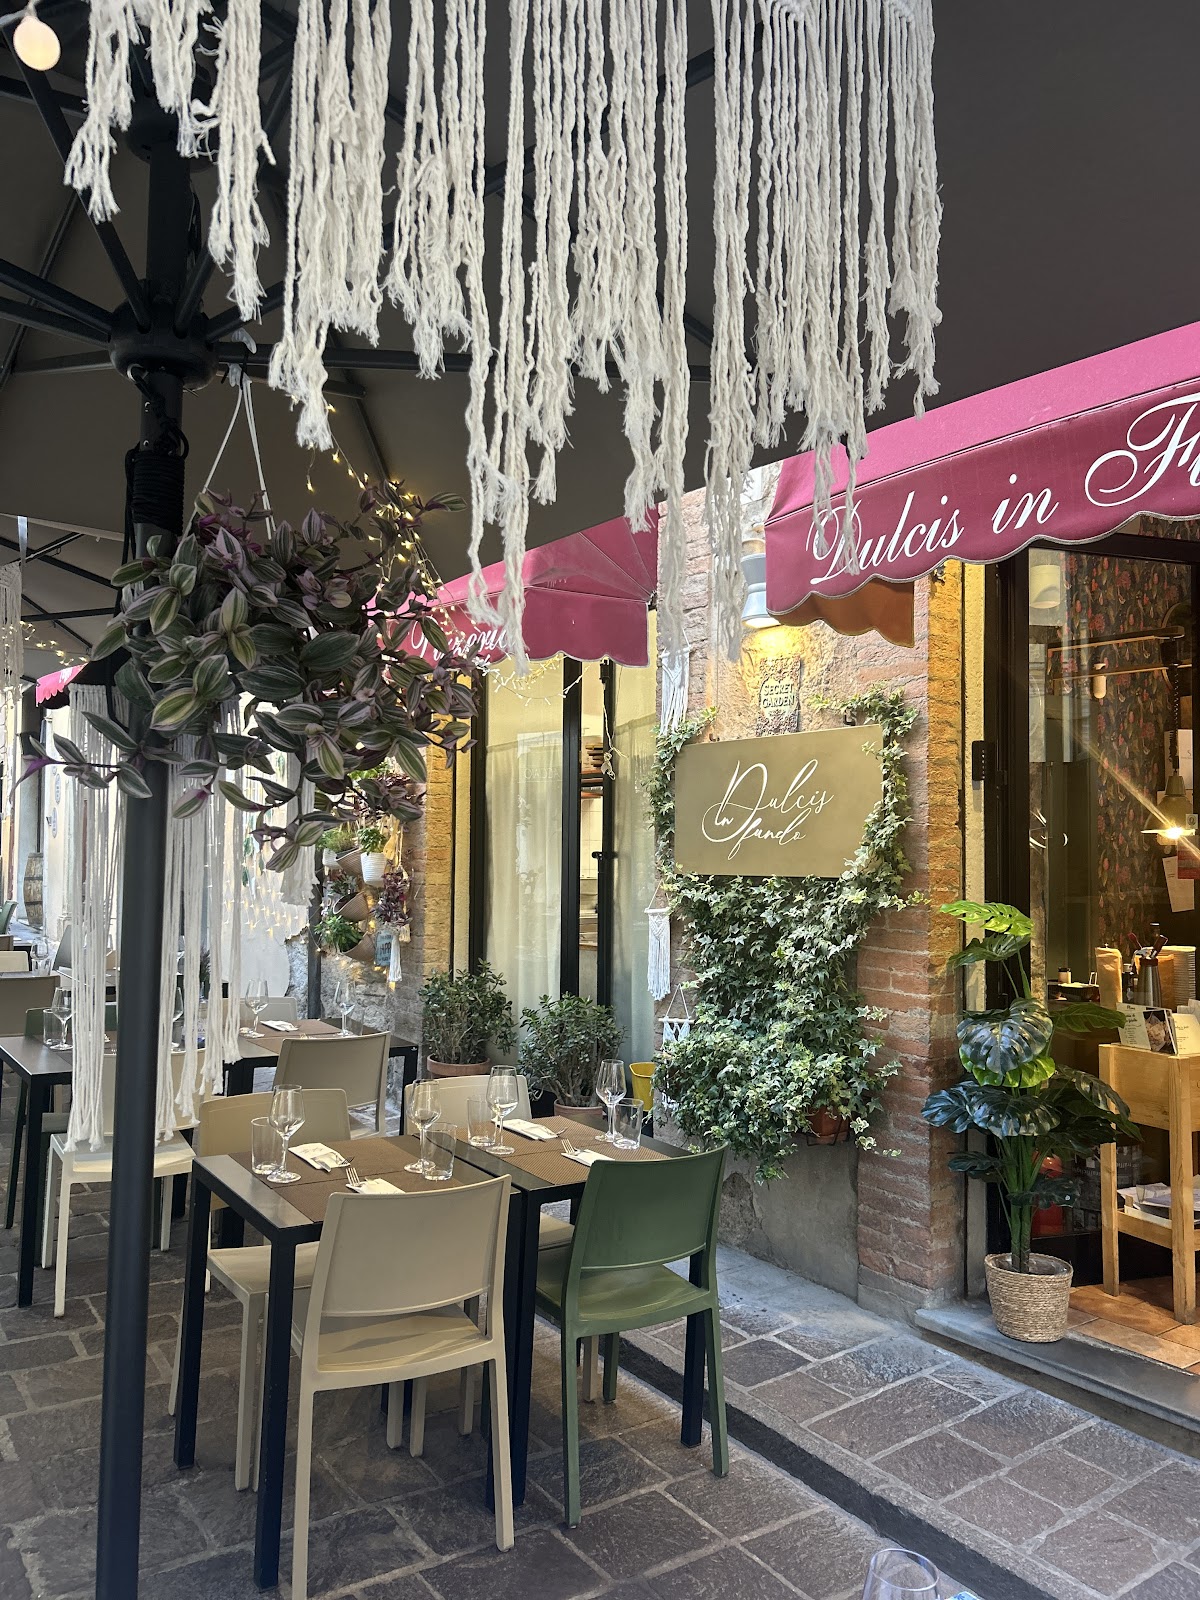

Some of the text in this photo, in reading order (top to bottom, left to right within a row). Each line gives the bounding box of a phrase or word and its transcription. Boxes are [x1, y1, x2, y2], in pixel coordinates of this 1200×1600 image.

[805, 491, 964, 585] Dulcis
[992, 474, 1059, 534] in
[761, 695, 796, 709] GARDEN
[762, 683, 795, 696] SECRET
[702, 759, 834, 842] Dulcis
